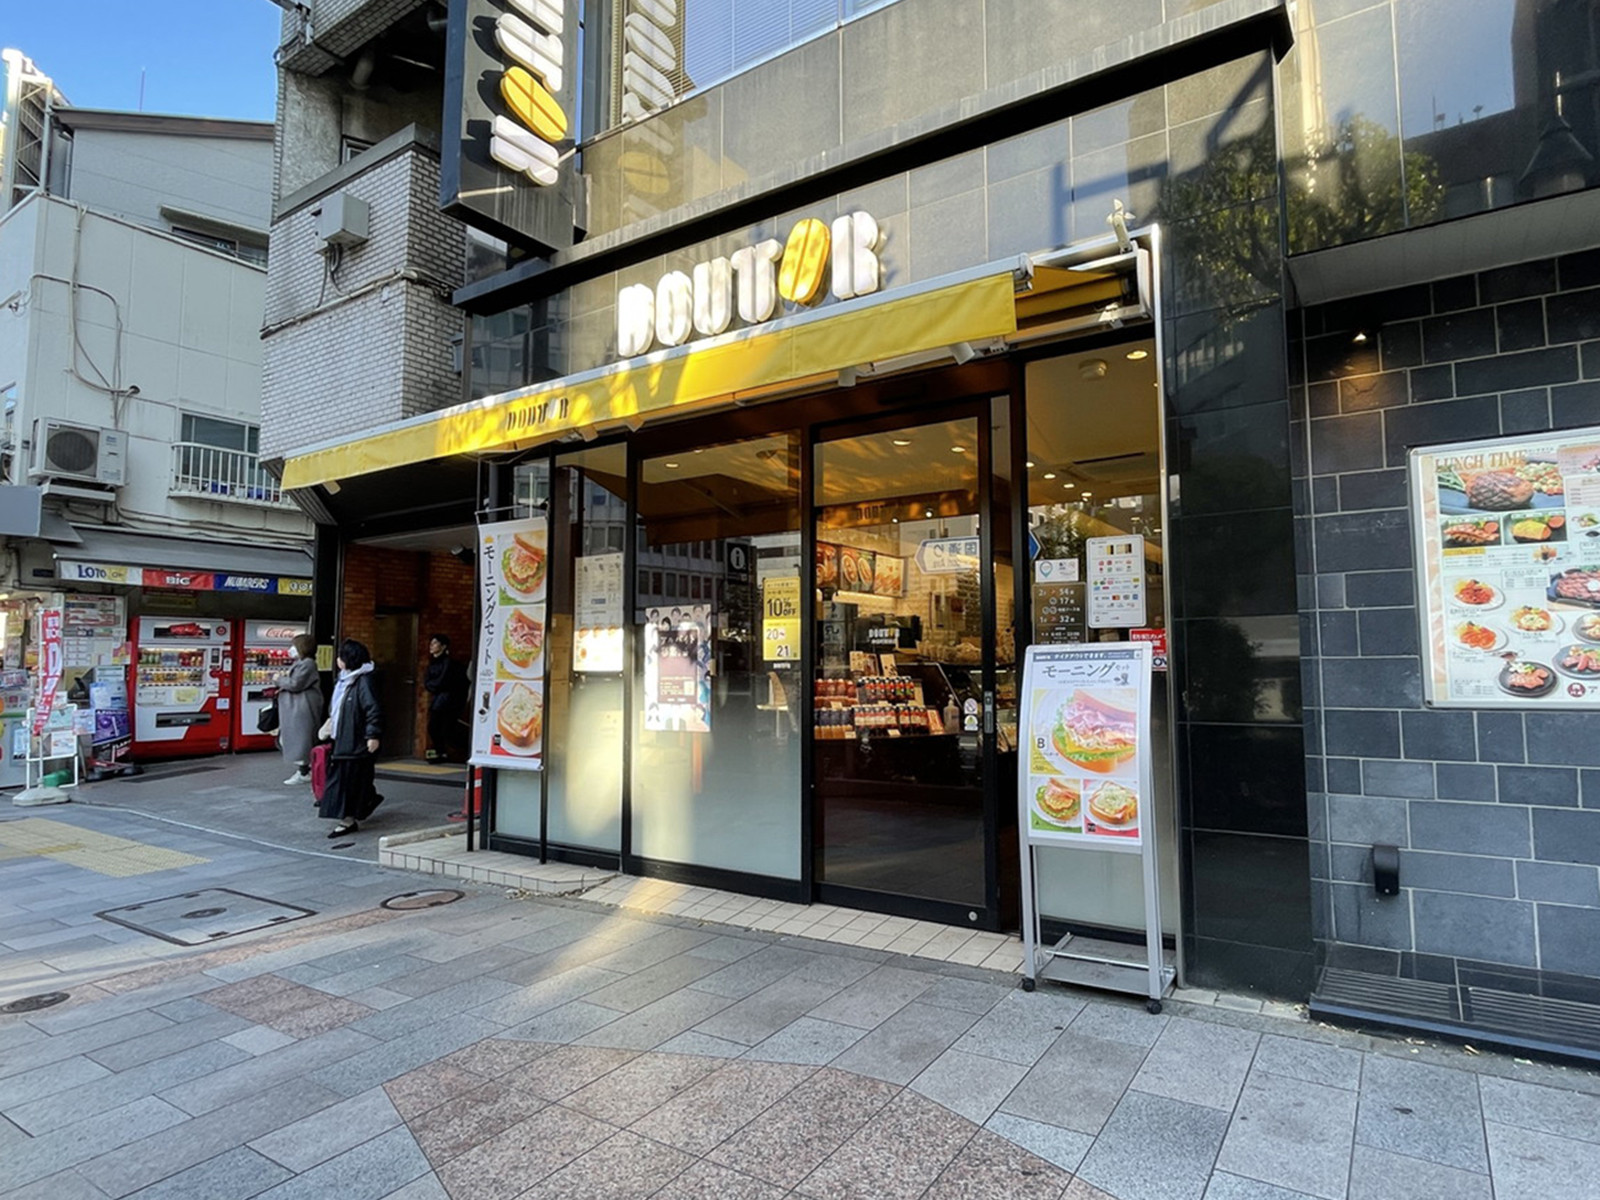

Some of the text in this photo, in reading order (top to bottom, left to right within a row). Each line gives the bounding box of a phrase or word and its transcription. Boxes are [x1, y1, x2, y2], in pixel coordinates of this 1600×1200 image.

[618, 210, 879, 358] DOUTOR
[507, 397, 569, 431] DOUTOR
[1435, 449, 1528, 472] LUNCH TIME
[77, 564, 107, 578] LOTO
[482, 545, 498, 666] モーニングセット
[777, 645, 789, 657] 21
[1042, 661, 1116, 678] モーニング
